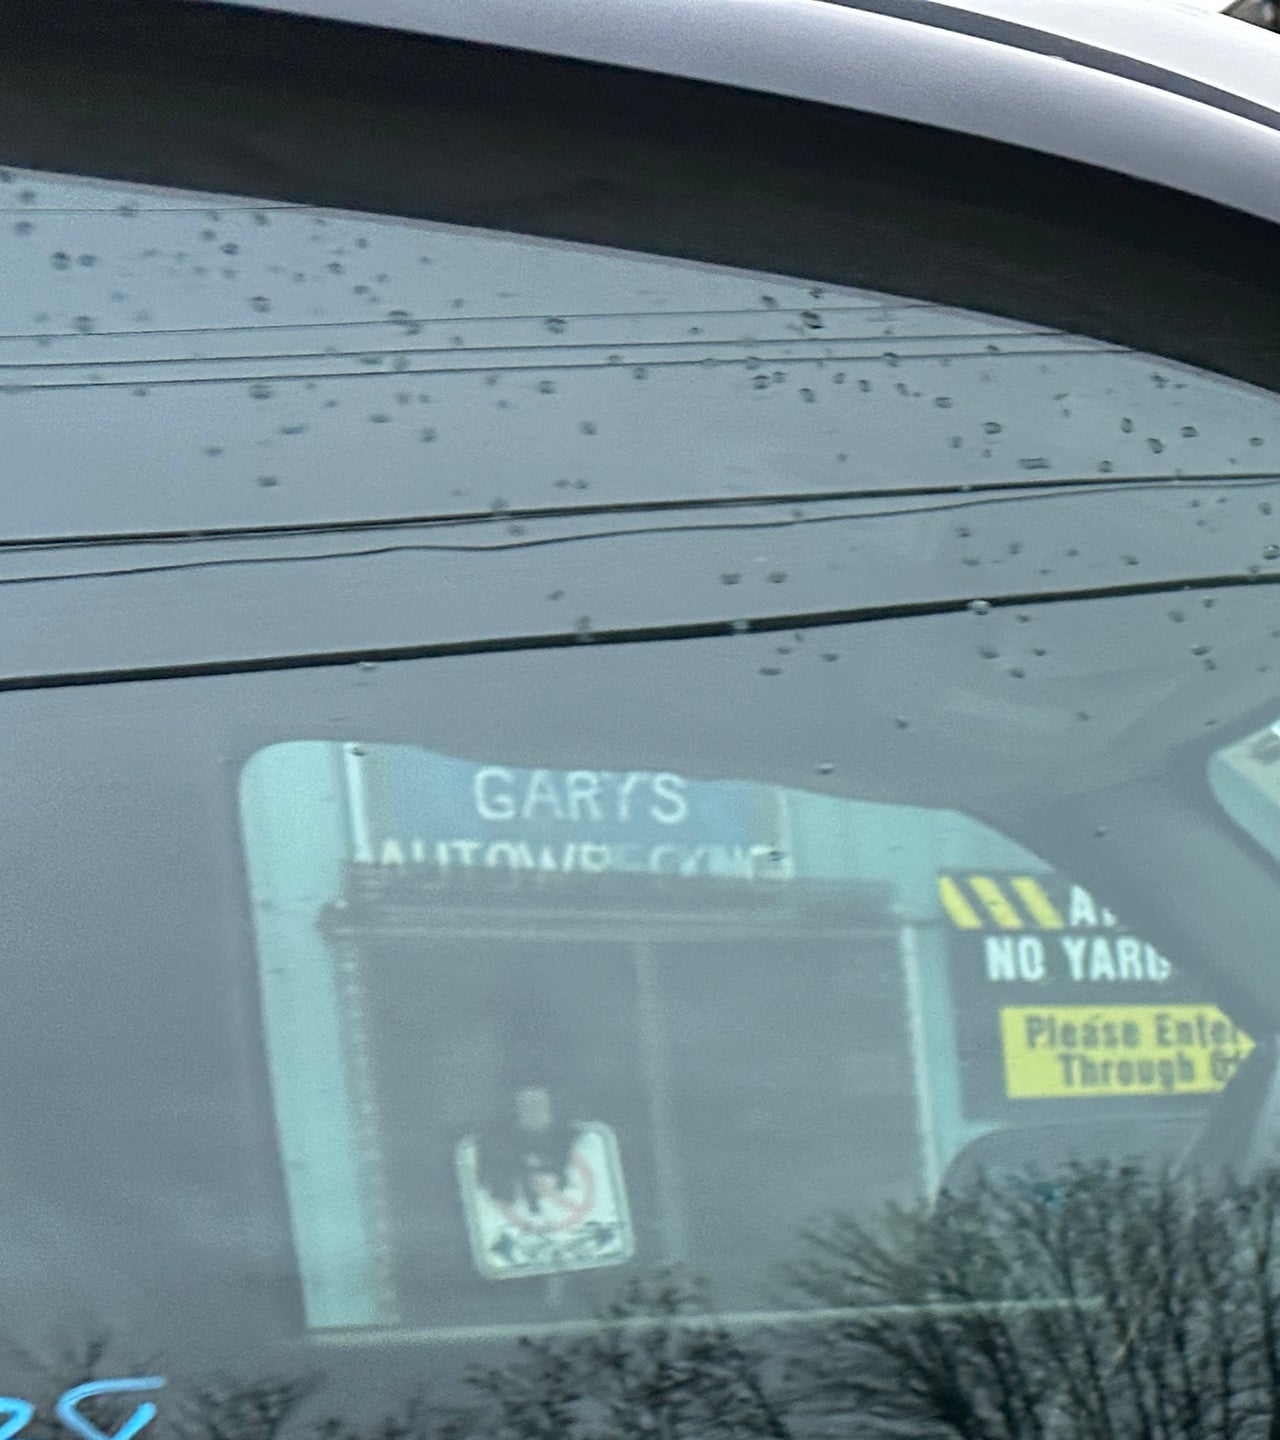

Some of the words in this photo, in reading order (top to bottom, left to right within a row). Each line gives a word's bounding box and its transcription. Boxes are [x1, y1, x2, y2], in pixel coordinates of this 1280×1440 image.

[473, 765, 687, 824] GARYS
[985, 936, 1045, 981] NO
[1024, 1014, 1140, 1049] Please
[1058, 1051, 1195, 1093] Through
